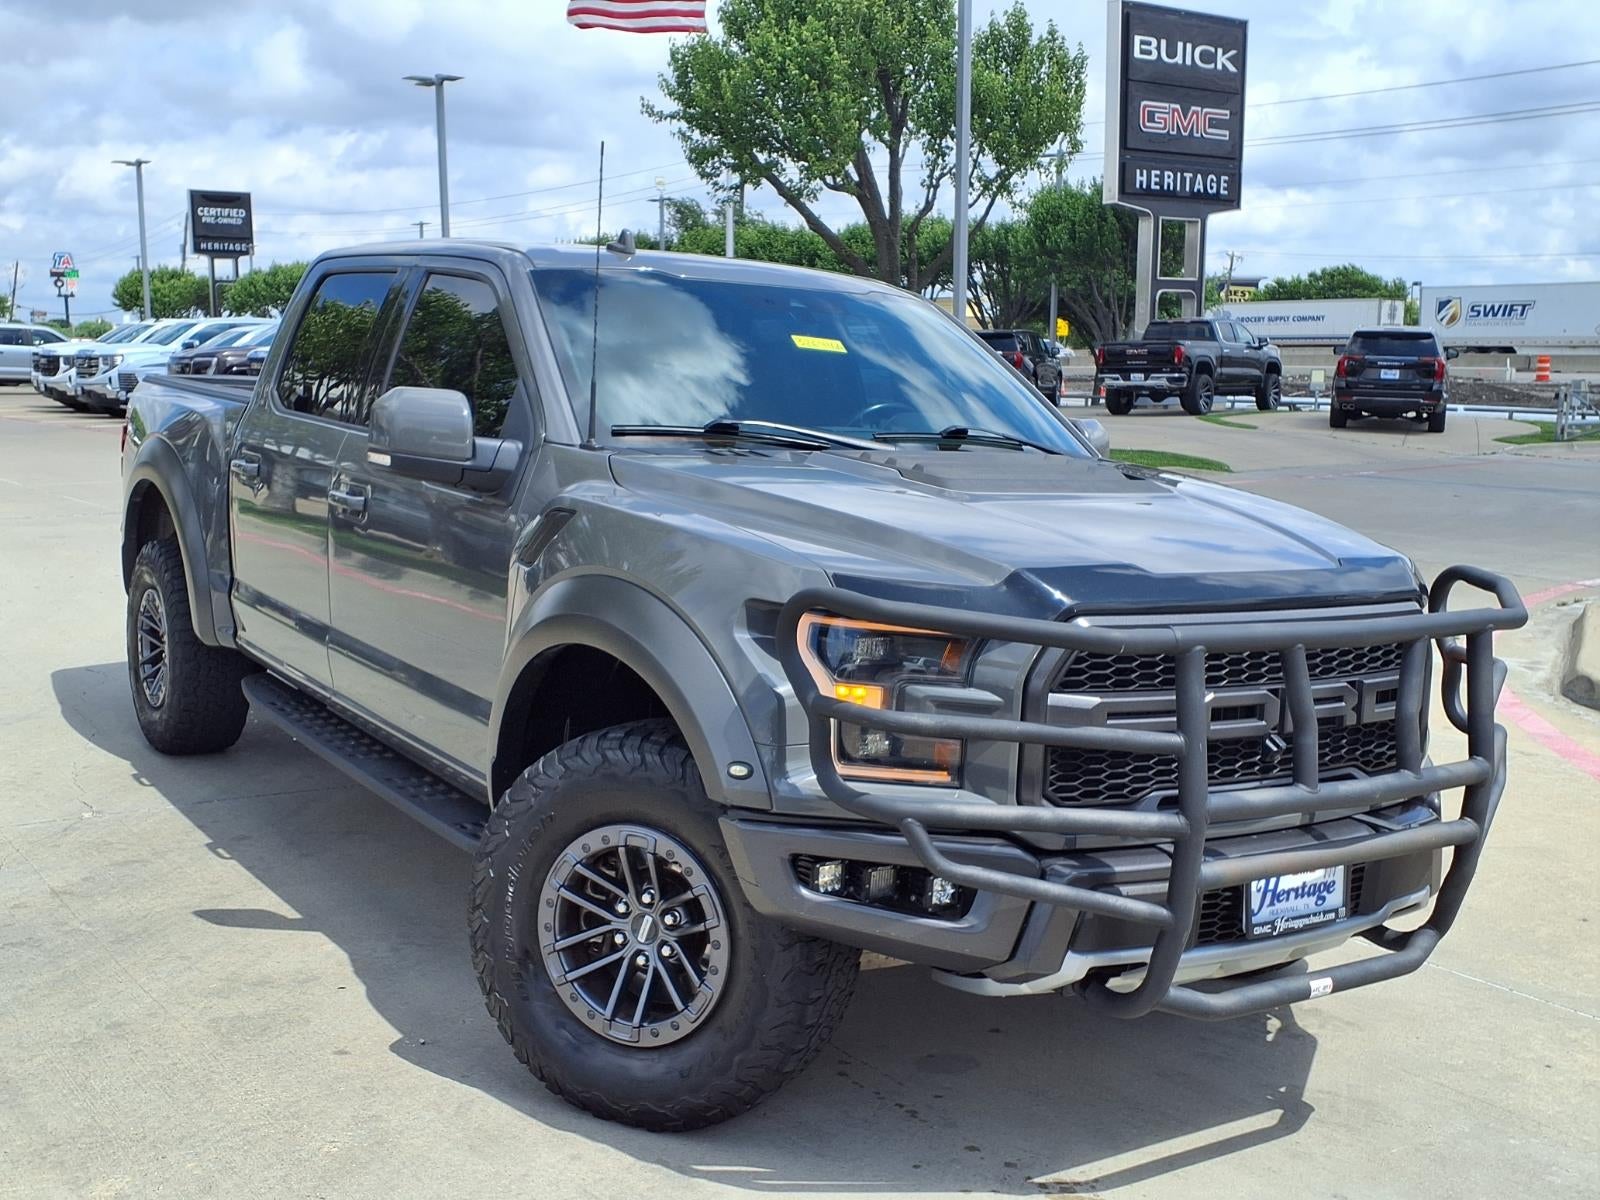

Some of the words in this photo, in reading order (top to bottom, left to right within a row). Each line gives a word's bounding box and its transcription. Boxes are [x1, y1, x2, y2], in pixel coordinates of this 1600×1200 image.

[1133, 34, 1239, 73] BUICK
[1139, 100, 1231, 141] GMC
[1135, 168, 1230, 195] HERITAGE
[197, 206, 246, 218] CERTIFIED
[201, 217, 243, 225] PRE-OWNED
[200, 241, 248, 252] HERITAGE
[1467, 302, 1533, 318] SWIFT
[1292, 314, 1325, 322] COMPANY
[1252, 874, 1336, 917] Heritage
[1253, 925, 1272, 935] GMC
